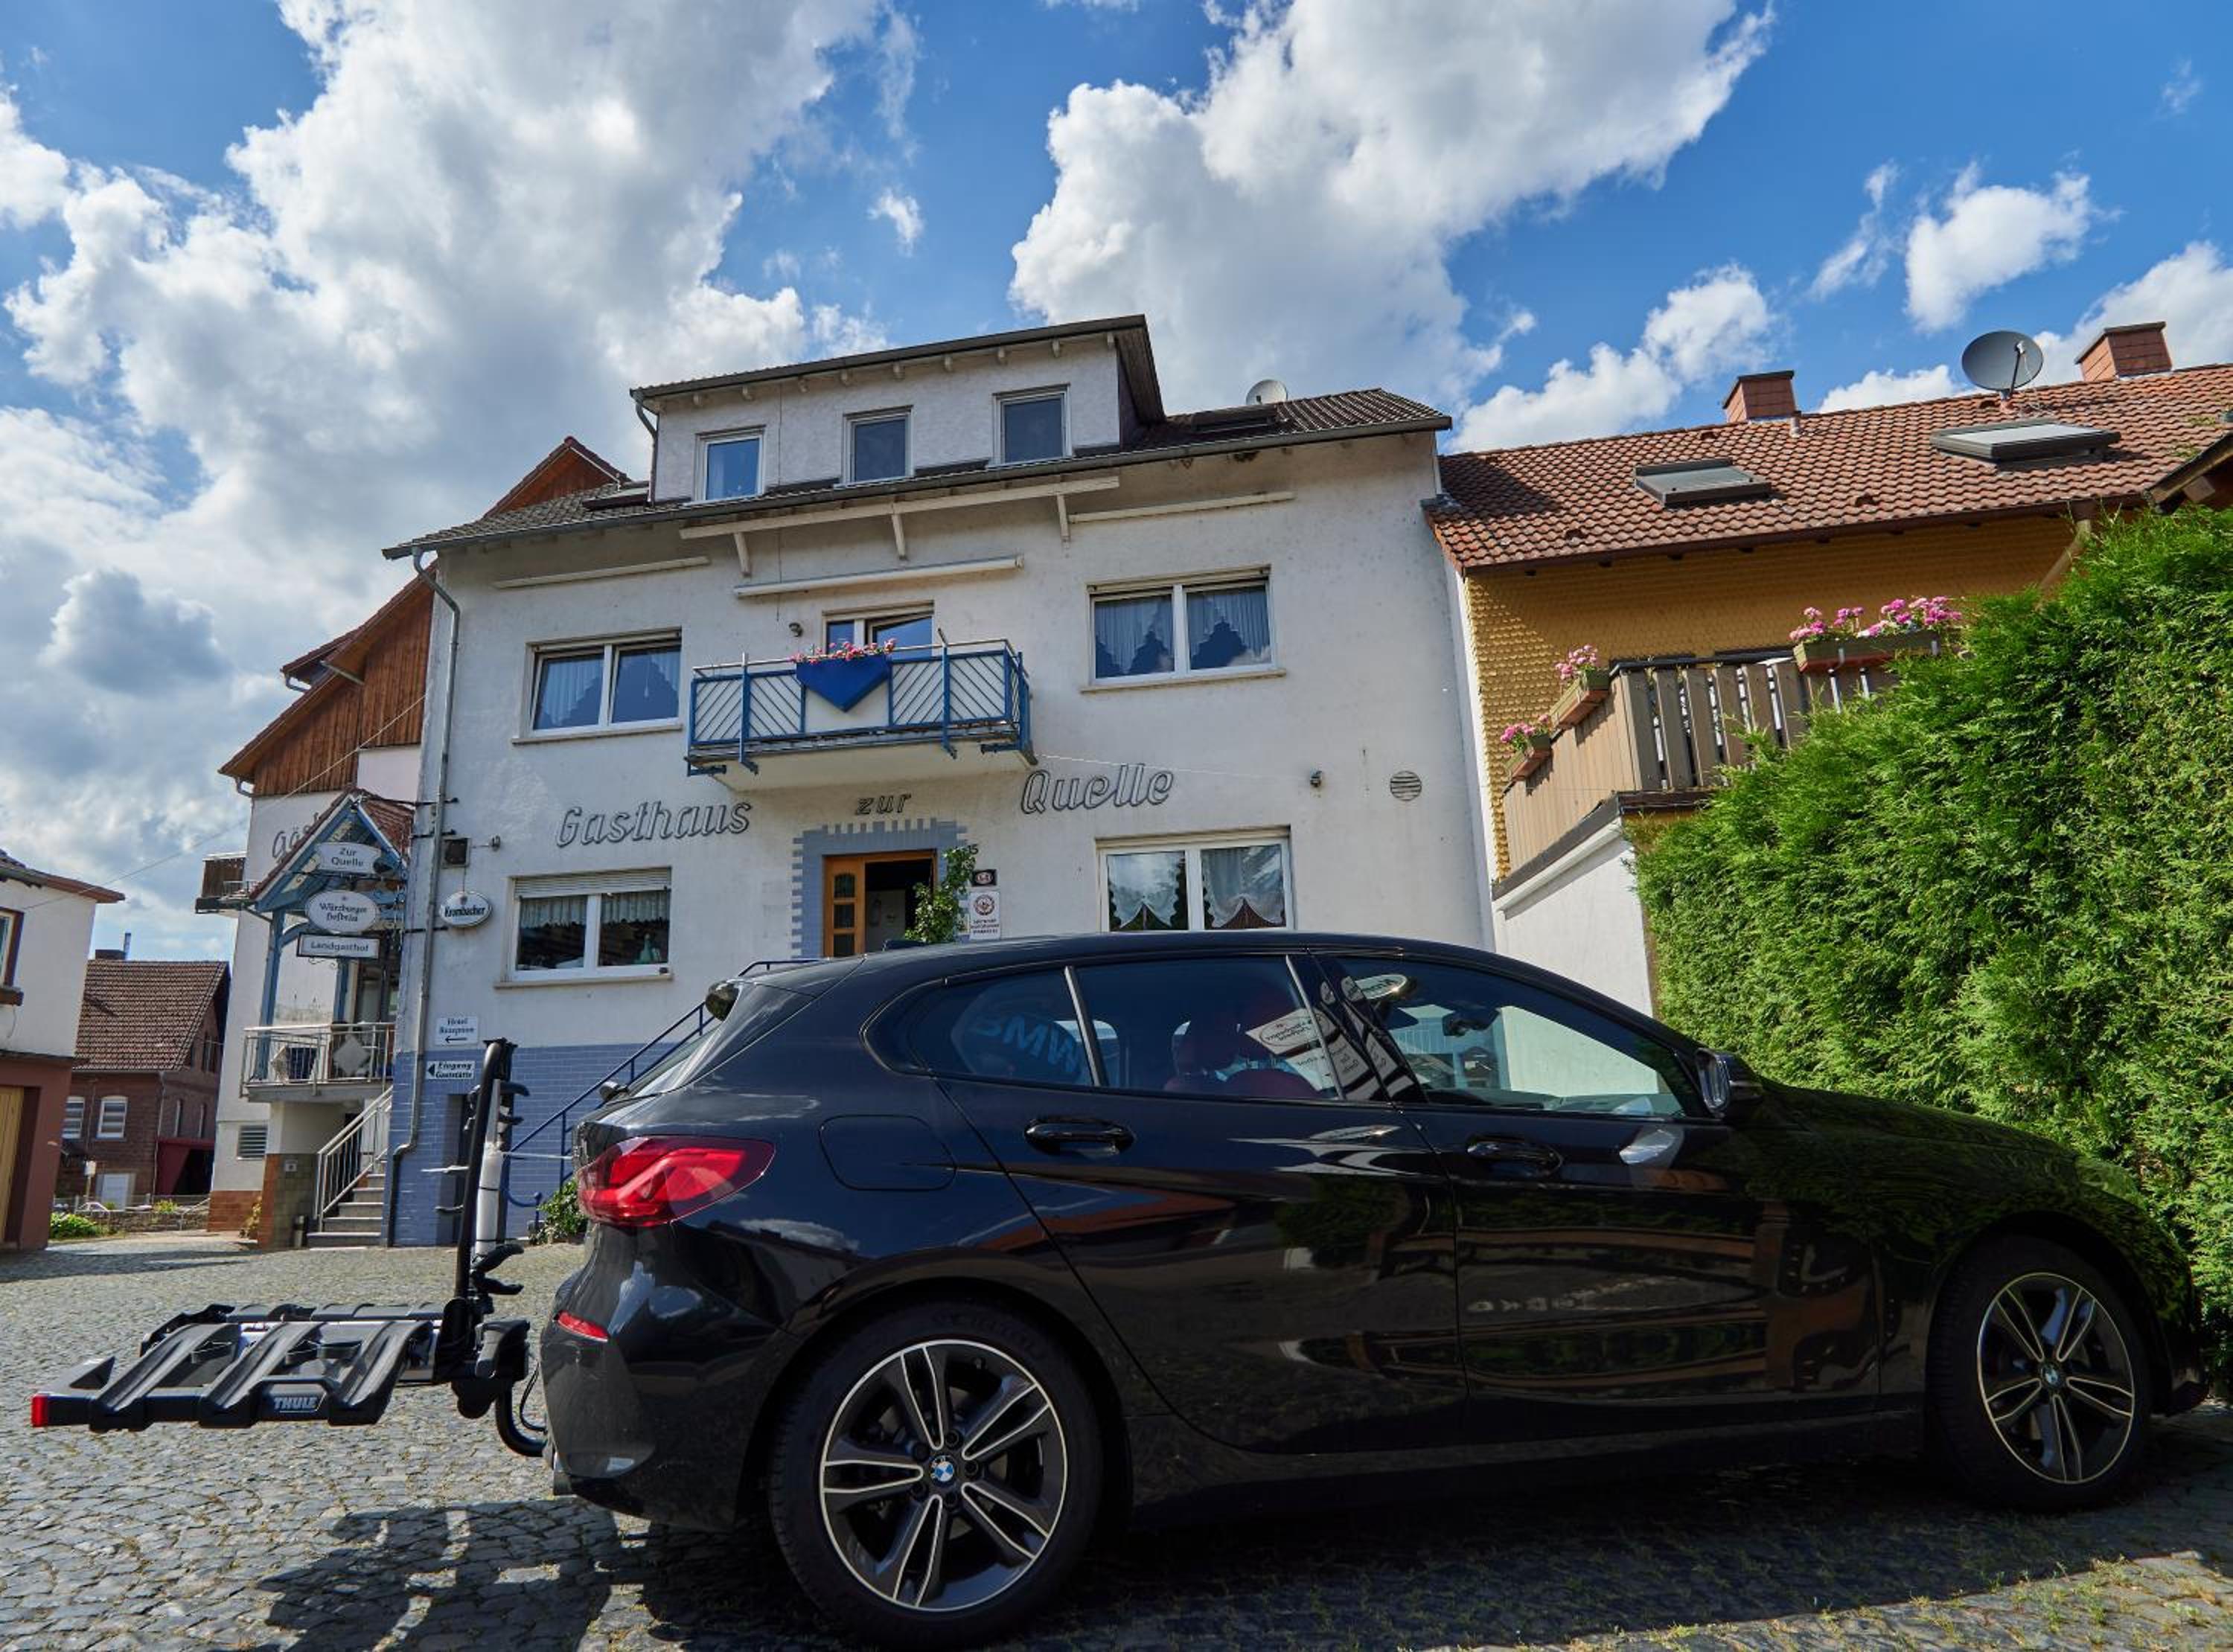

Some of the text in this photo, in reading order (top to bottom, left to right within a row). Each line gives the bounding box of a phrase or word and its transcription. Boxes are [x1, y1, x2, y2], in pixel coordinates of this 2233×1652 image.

[557, 763, 1174, 848] Gasthaus zur Quelle
[331, 857, 364, 866] Quelle
[310, 941, 369, 953] Landgasthof
[273, 1397, 318, 1410] THULE
